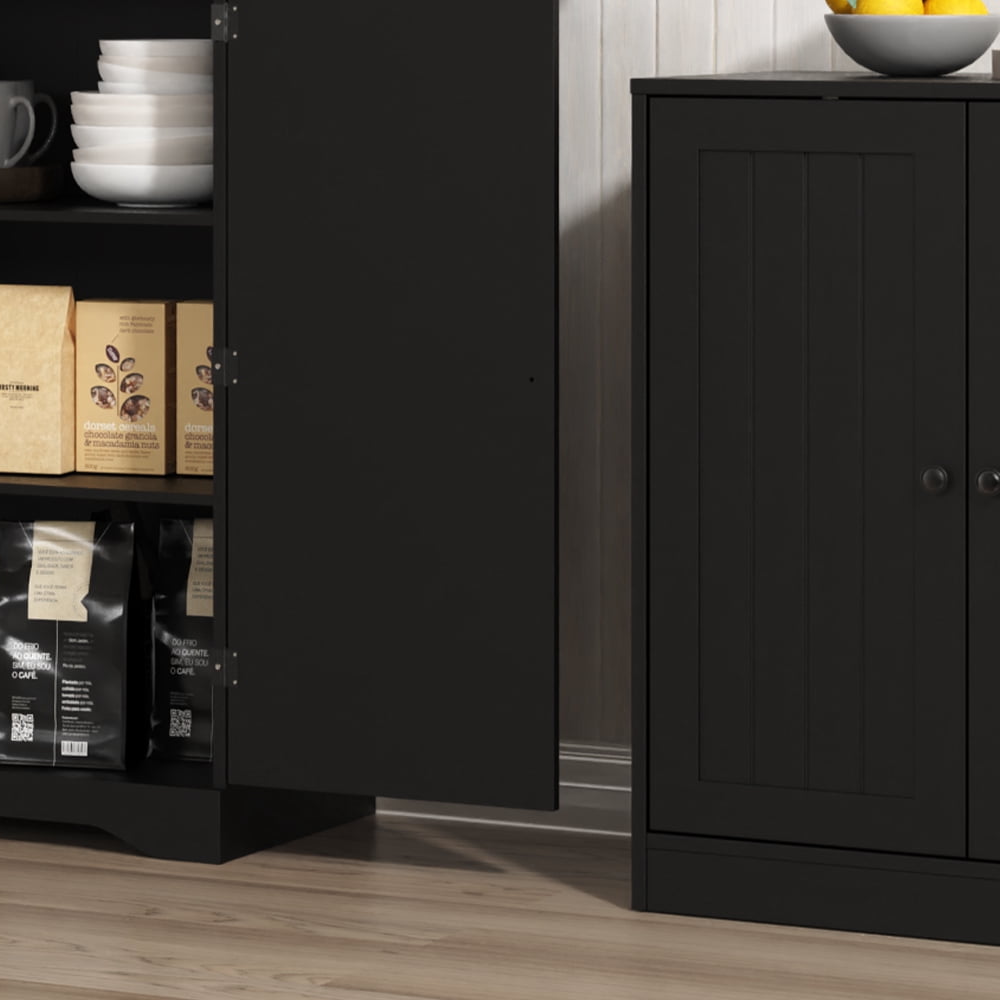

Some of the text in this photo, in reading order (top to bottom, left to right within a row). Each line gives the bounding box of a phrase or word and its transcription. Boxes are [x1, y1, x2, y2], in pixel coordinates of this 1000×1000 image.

[84, 420, 156, 432] dorset cereals
[84, 430, 158, 442] chocolate granola
[184, 432, 213, 440] chocol
[84, 439, 160, 450] & macadamia nuts
[170, 667, 176, 675] O
